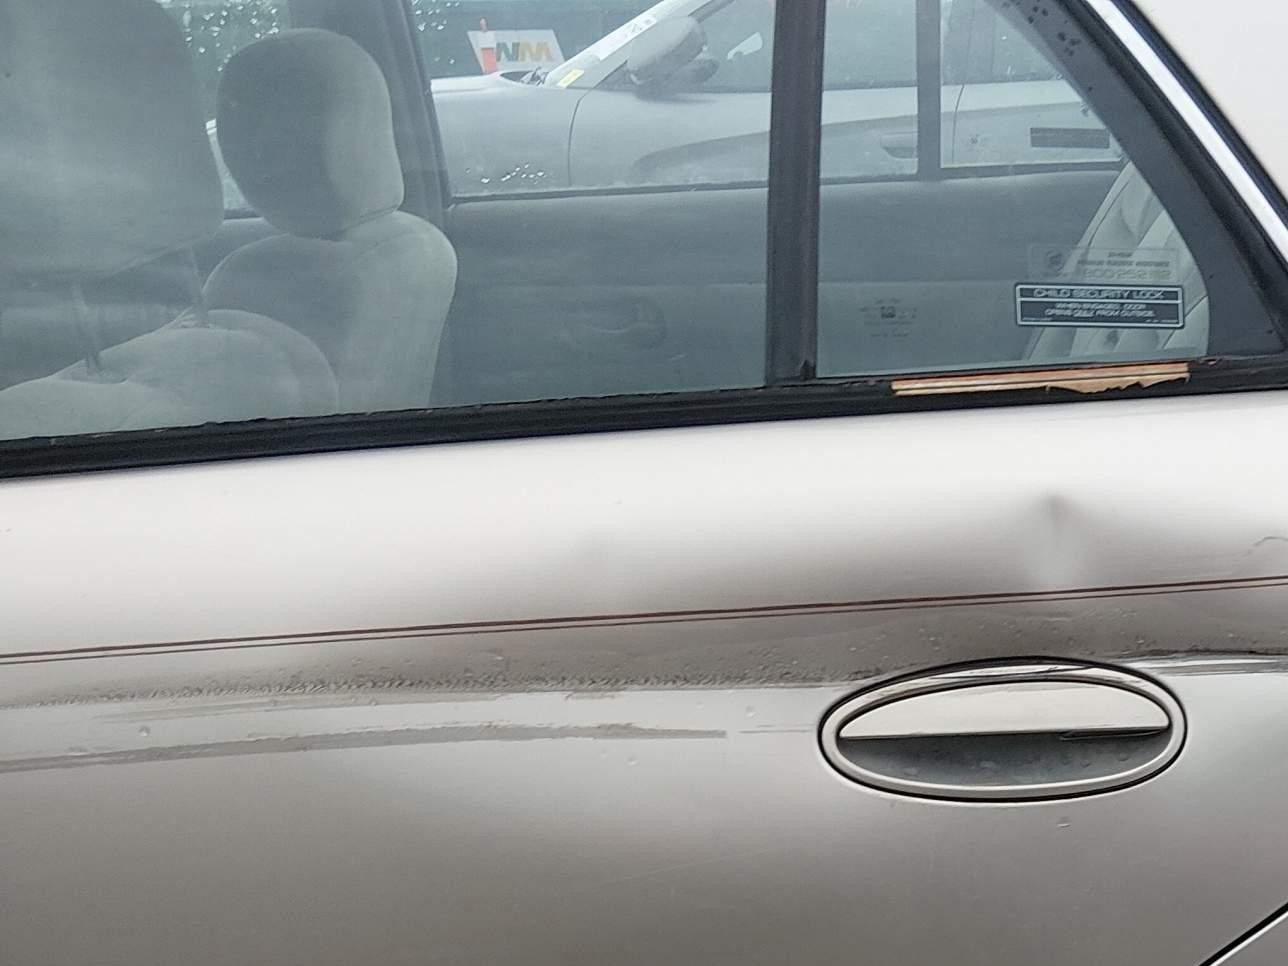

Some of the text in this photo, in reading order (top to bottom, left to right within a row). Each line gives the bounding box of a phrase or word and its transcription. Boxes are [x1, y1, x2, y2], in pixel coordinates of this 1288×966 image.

[1033, 288, 1165, 300] CHILD SECURITY LOCK
